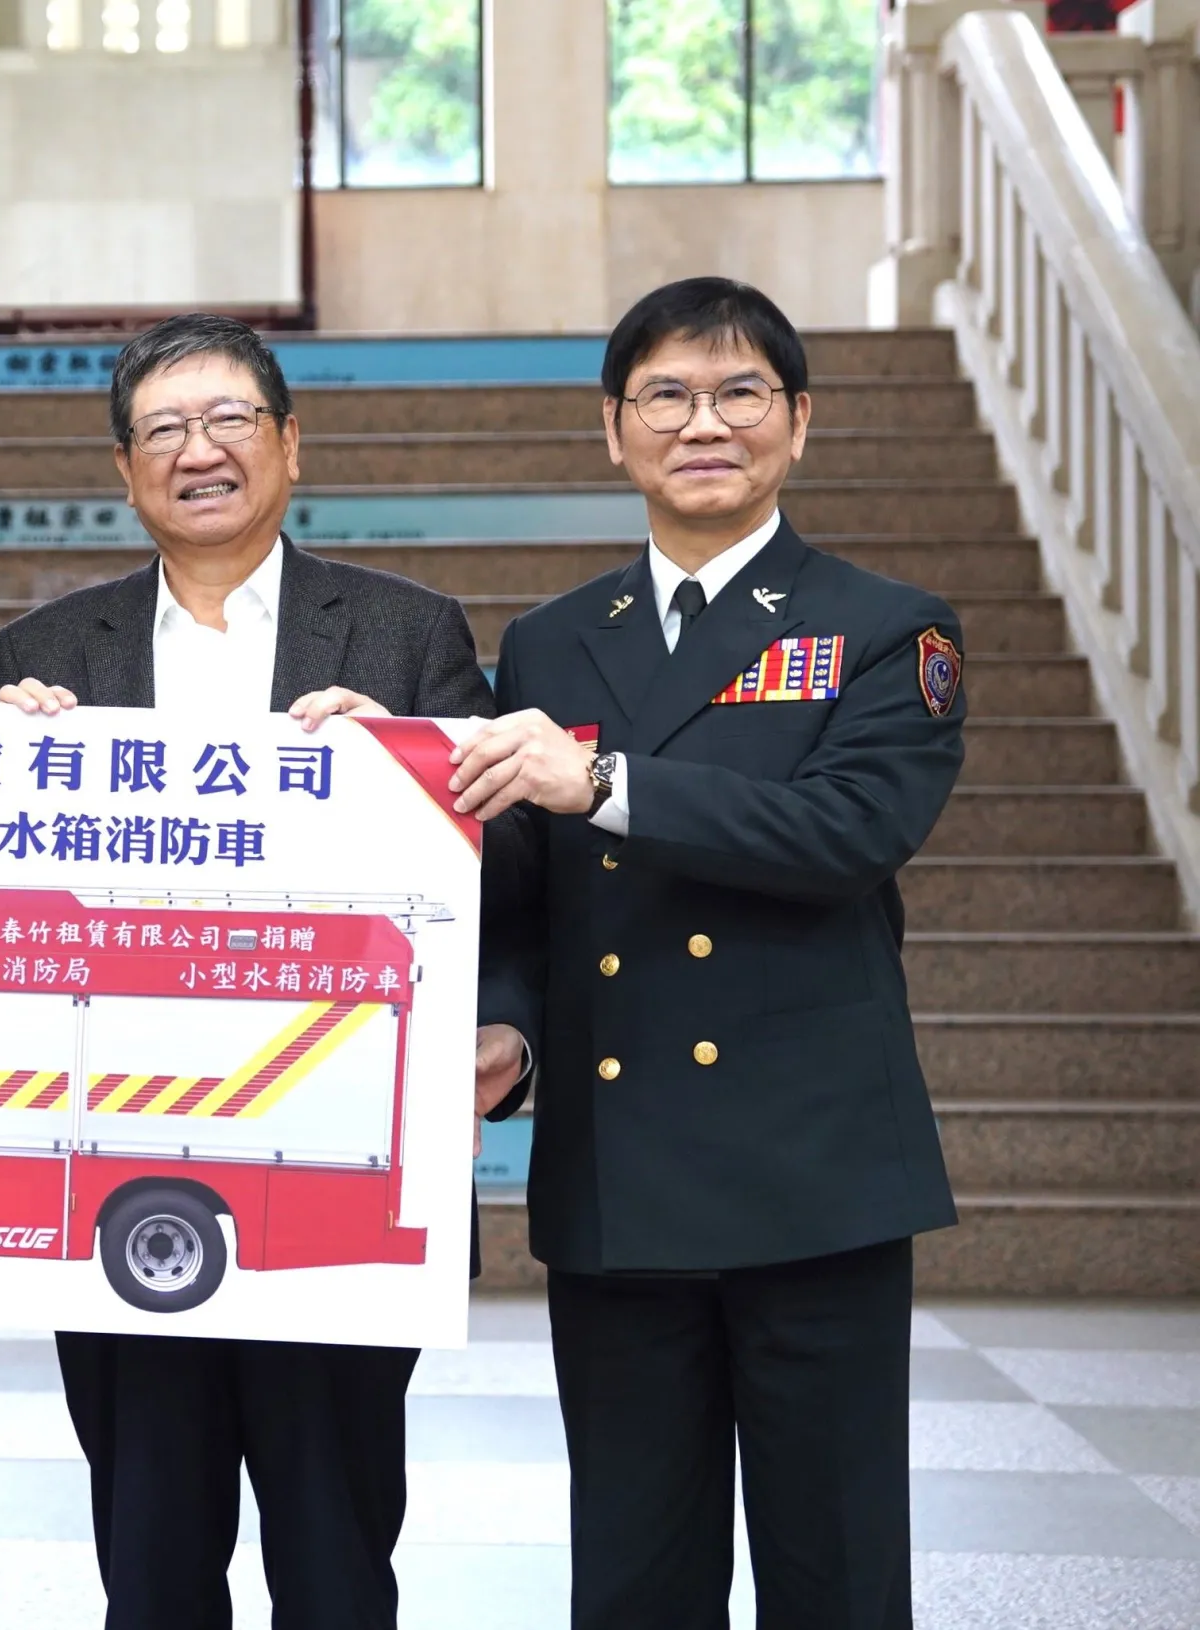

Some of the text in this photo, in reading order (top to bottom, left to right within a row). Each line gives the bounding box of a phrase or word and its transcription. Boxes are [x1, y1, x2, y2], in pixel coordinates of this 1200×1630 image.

[0, 917, 316, 952] 春竹租賃有限公司 捐贈
[179, 961, 401, 996] 小型水箱消防車
